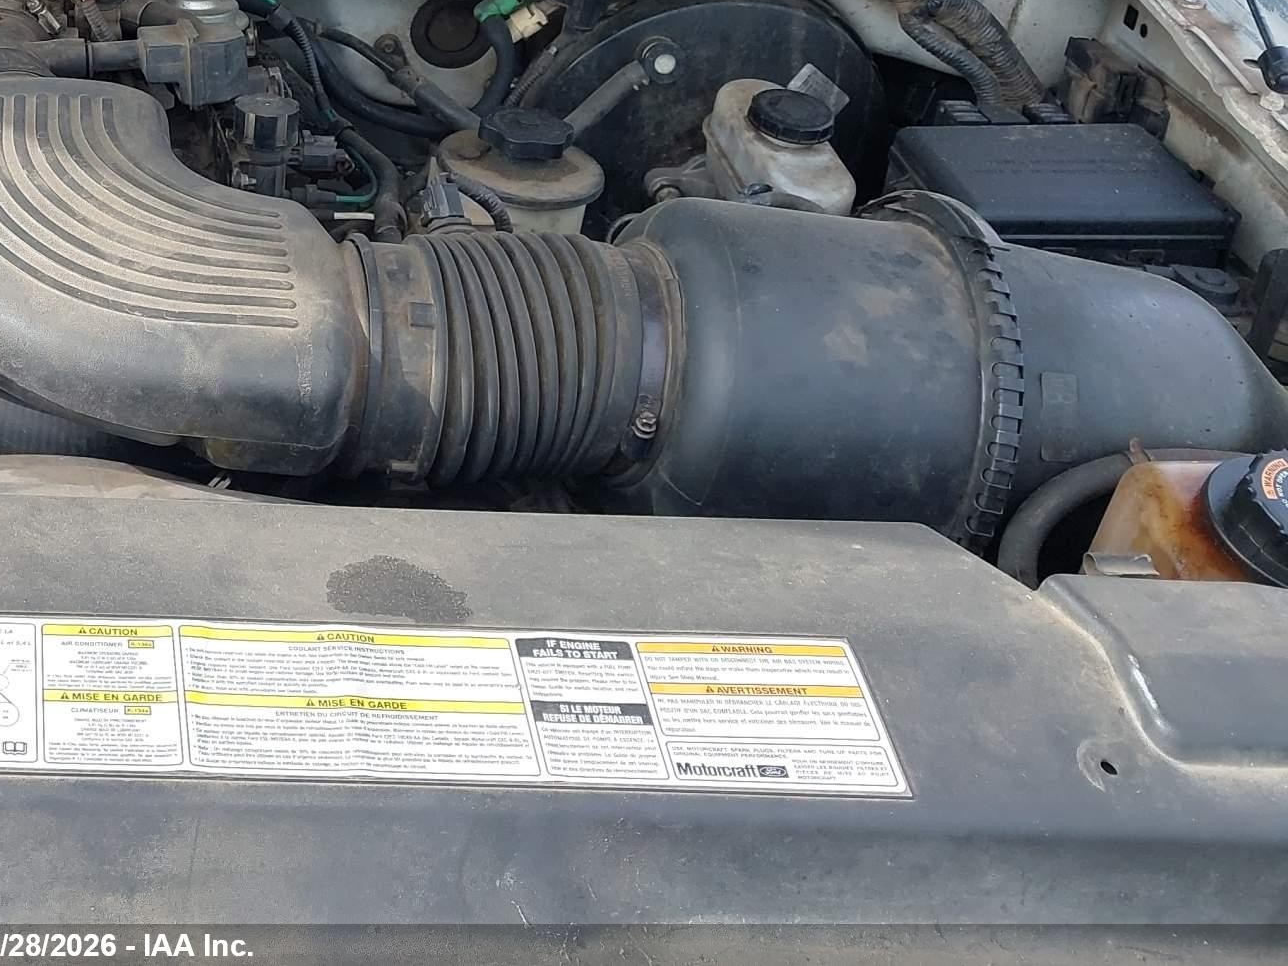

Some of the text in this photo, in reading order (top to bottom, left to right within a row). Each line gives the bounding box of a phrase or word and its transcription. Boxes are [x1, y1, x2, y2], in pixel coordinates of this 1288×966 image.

[1264, 461, 1286, 487] WARNING
[326, 633, 375, 643] CAUTION
[546, 639, 601, 650] IF ENGINE
[533, 649, 618, 659] FAILS TO START
[721, 646, 773, 654] WARNING
[717, 687, 808, 695] AVERTISSEMENT
[318, 698, 407, 710] MISE EN GARDE
[560, 704, 622, 714] SI LE MOTEUR
[543, 713, 577, 722] REFUSE
[579, 714, 592, 723] DE
[676, 762, 758, 778] Motorcraft
